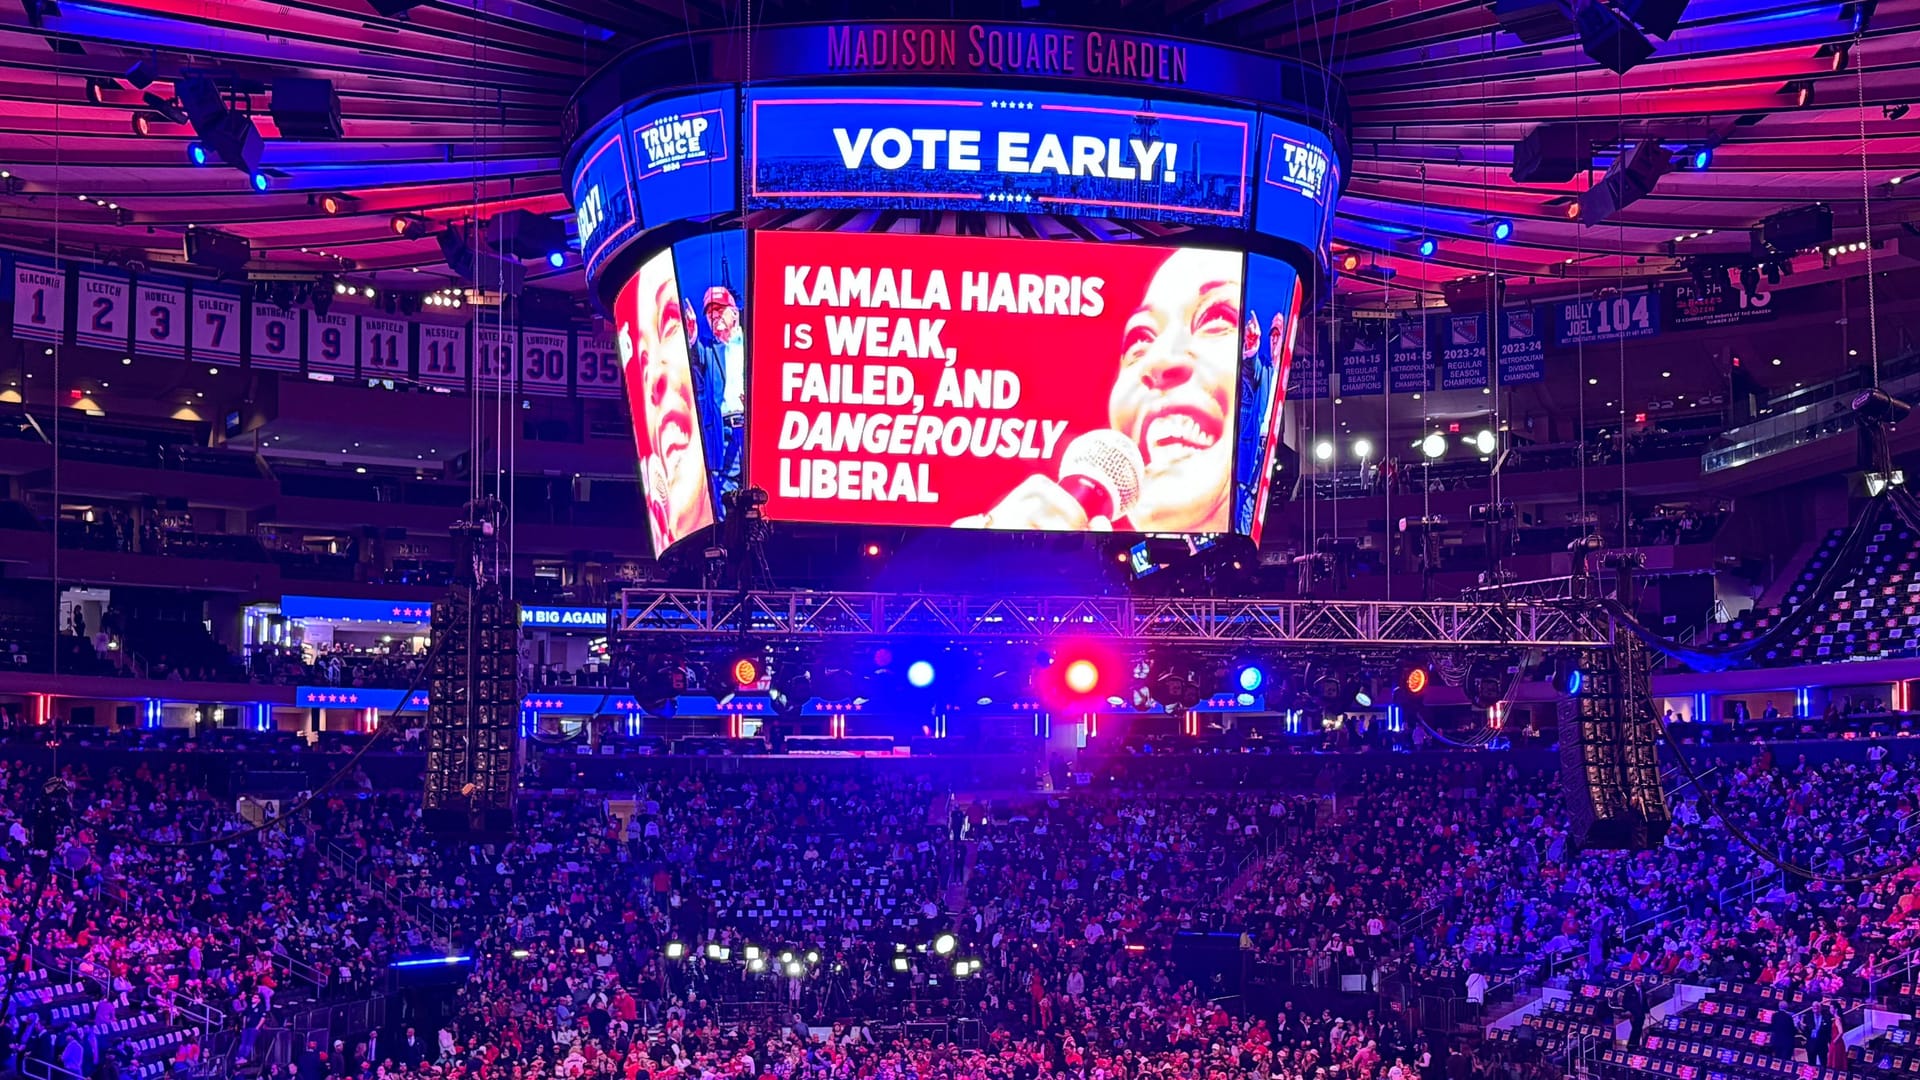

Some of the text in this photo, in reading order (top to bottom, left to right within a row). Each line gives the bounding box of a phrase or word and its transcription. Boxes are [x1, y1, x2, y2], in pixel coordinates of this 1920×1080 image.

[827, 24, 1189, 84] MADISON SQUARE GARDEN
[641, 117, 708, 150] TRUMP
[648, 136, 701, 162] VANCE
[833, 127, 1179, 183] VOTE EARLY!
[31, 288, 46, 324] 1
[86, 282, 122, 297] LEETCH
[144, 291, 177, 305] HOWELL
[198, 299, 234, 313] GILBERT
[784, 265, 1106, 317] KAMALA HARRIS
[1676, 284, 1722, 299] PHSH
[92, 297, 114, 332] 2
[150, 306, 170, 340] 3
[1564, 302, 1593, 321] BILLY
[1597, 295, 1650, 333] 104
[206, 312, 227, 348] 7
[266, 320, 286, 354] 9
[321, 327, 341, 360] 9
[425, 328, 459, 340] MESSIER
[783, 315, 957, 366] IS WEAK,
[1567, 320, 1593, 337] JOEL
[370, 333, 399, 367] 11
[427, 340, 457, 374] 11
[478, 343, 512, 376] 19
[1343, 353, 1382, 366] 2014-15
[1443, 347, 1486, 360] 2023-24
[1501, 340, 1542, 355] 2023-24
[526, 348, 564, 381] 30
[579, 351, 619, 384] 35
[1345, 366, 1379, 376] REGULAR
[1347, 374, 1377, 383] SEASON
[1391, 362, 1435, 373] METROPOLIAN
[1447, 360, 1483, 370] REGULAR
[1450, 369, 1480, 378] SEASON
[781, 362, 1021, 415] FAILED, AND
[1394, 379, 1431, 389] CHAMPIOS
[1443, 376, 1487, 388] CHAMPIONS
[778, 411, 1069, 460] DANGEROUSLY
[779, 458, 939, 503] LIBERAL
[535, 610, 560, 623] BIG
[562, 611, 607, 624] AGAIN
